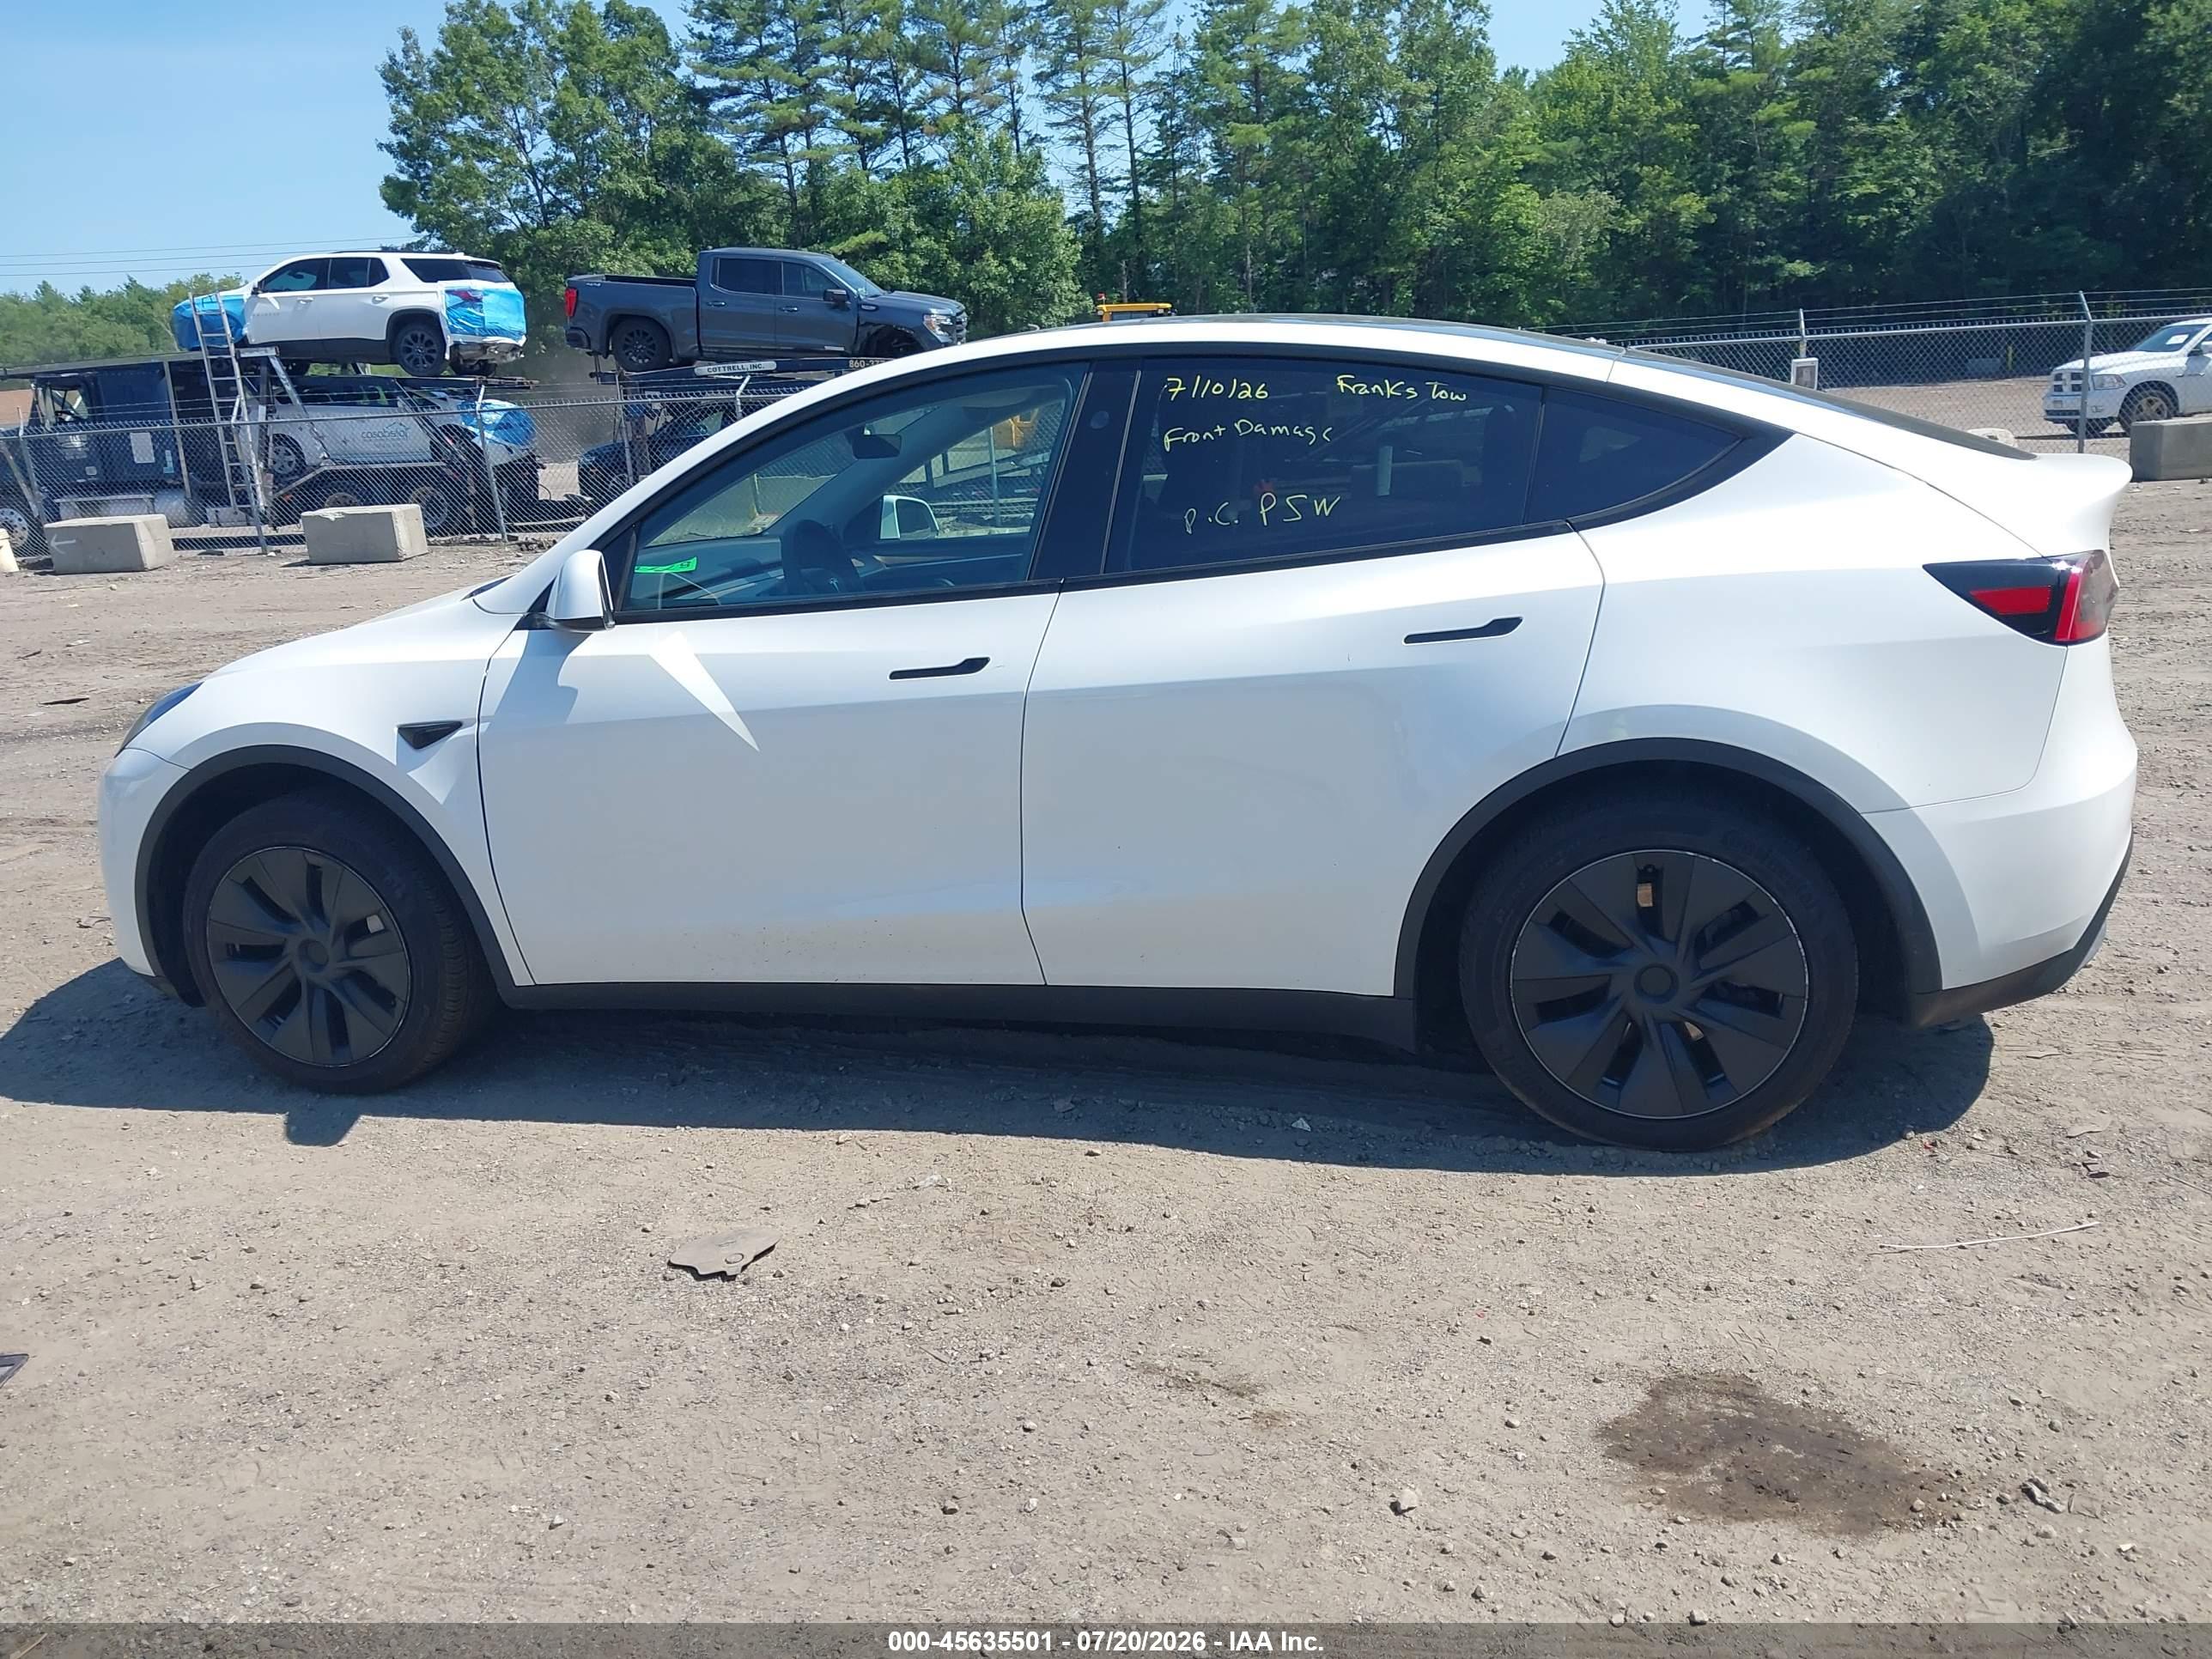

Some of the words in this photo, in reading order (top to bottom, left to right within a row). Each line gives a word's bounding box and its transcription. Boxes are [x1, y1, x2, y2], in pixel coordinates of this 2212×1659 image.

[707, 364, 749, 373] COTTRELL,
[1167, 375, 1268, 401] 7/10/26
[1425, 381, 1467, 401] Tow
[1164, 425, 1226, 452] Front
